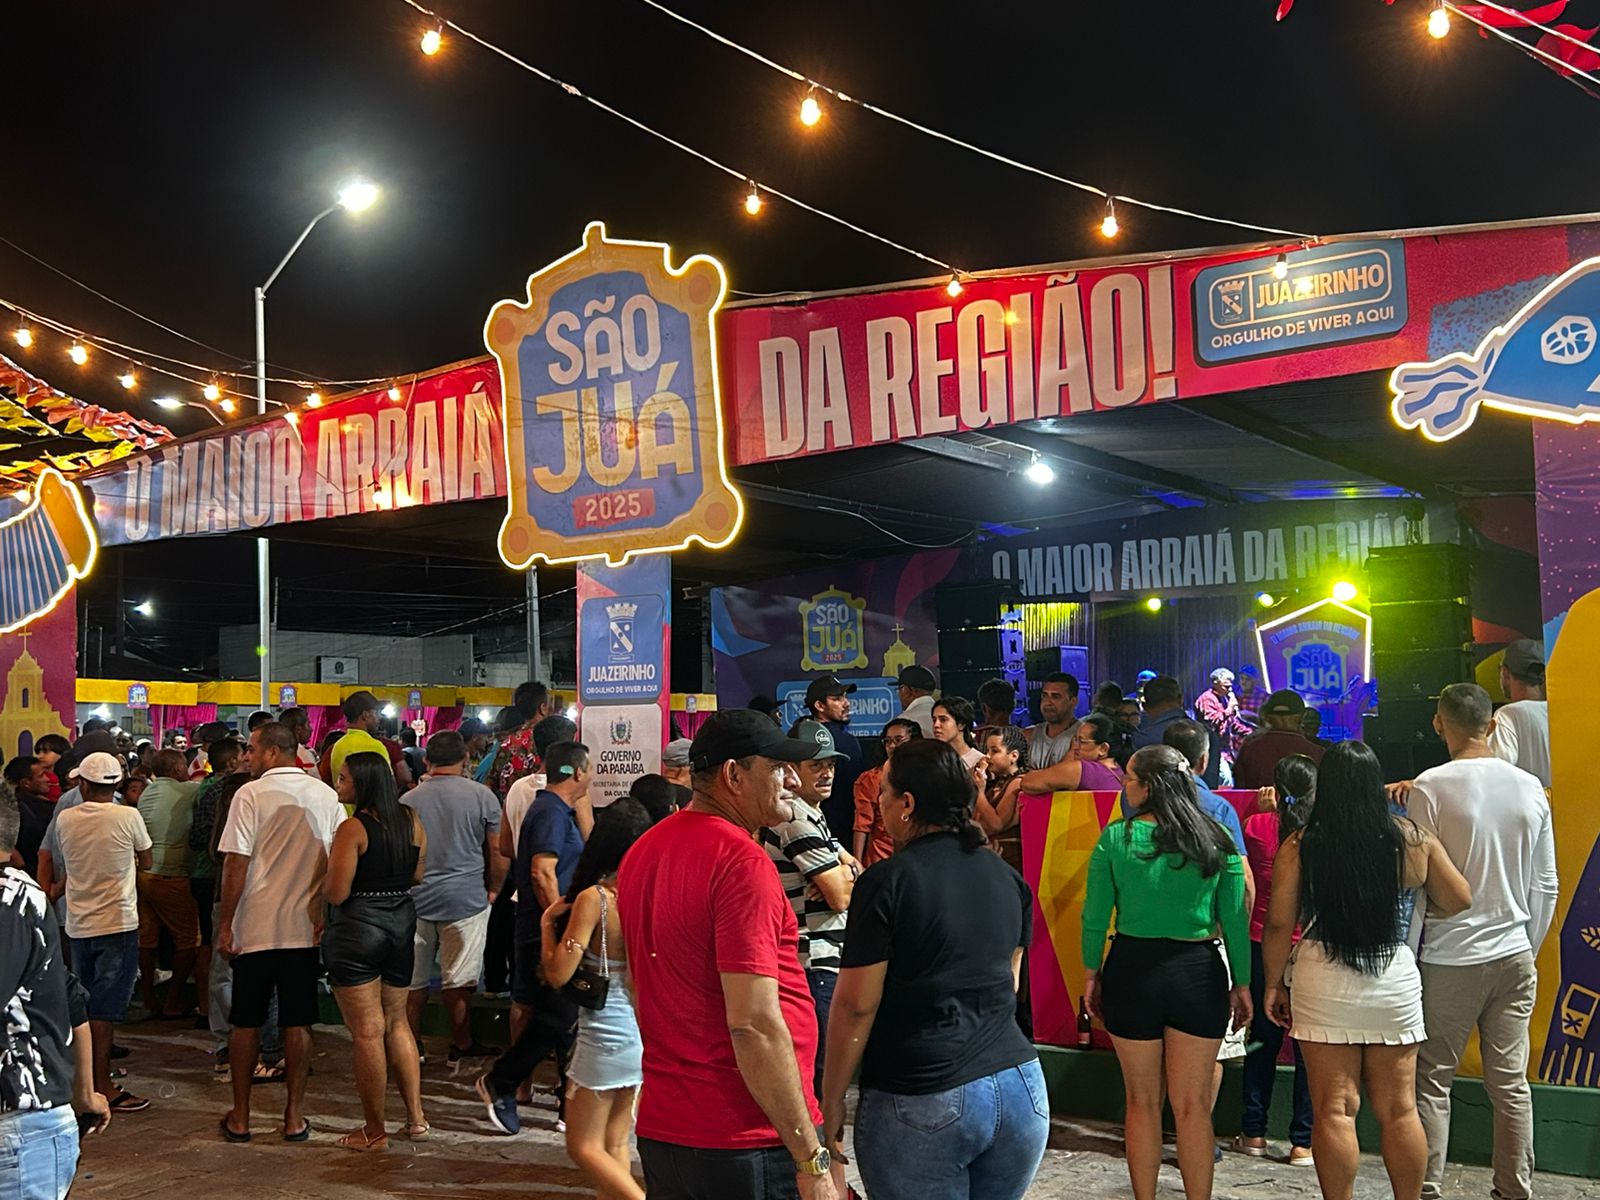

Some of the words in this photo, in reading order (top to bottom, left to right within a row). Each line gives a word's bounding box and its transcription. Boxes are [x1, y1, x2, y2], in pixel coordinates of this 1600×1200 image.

[1256, 264, 1385, 309] JUAZEIRINHO
[545, 294, 662, 386] SÃO
[1211, 323, 1283, 349] ORGULHO
[1286, 321, 1305, 337] DE
[1308, 313, 1352, 332] VIVER
[1356, 306, 1395, 324] AQUI
[758, 326, 855, 458] DA
[865, 265, 1178, 443] REGIÃO!
[532, 361, 695, 493] JUÁ
[125, 455, 153, 541] O
[160, 428, 302, 537] MAIOR
[315, 381, 496, 518] ARRAIÁ
[585, 492, 641, 522] 2025
[1017, 542, 1114, 597] MAIOR
[1120, 528, 1237, 591] ARRAIÁ
[1243, 528, 1288, 583] DA
[815, 602, 849, 625] SÃO
[811, 621, 857, 653] JUÁ
[825, 653, 842, 662] 2025
[1299, 648, 1333, 667] SÃO
[588, 663, 655, 683] JUAZEIRINHO
[1296, 664, 1340, 690] JUÁ
[586, 687, 614, 695] ORGULHO
[615, 686, 623, 694] DE
[624, 685, 641, 693] VIVER
[597, 764, 609, 775] DA
[609, 761, 645, 775] PARAÍBA
[600, 750, 642, 762] GOVERNO
